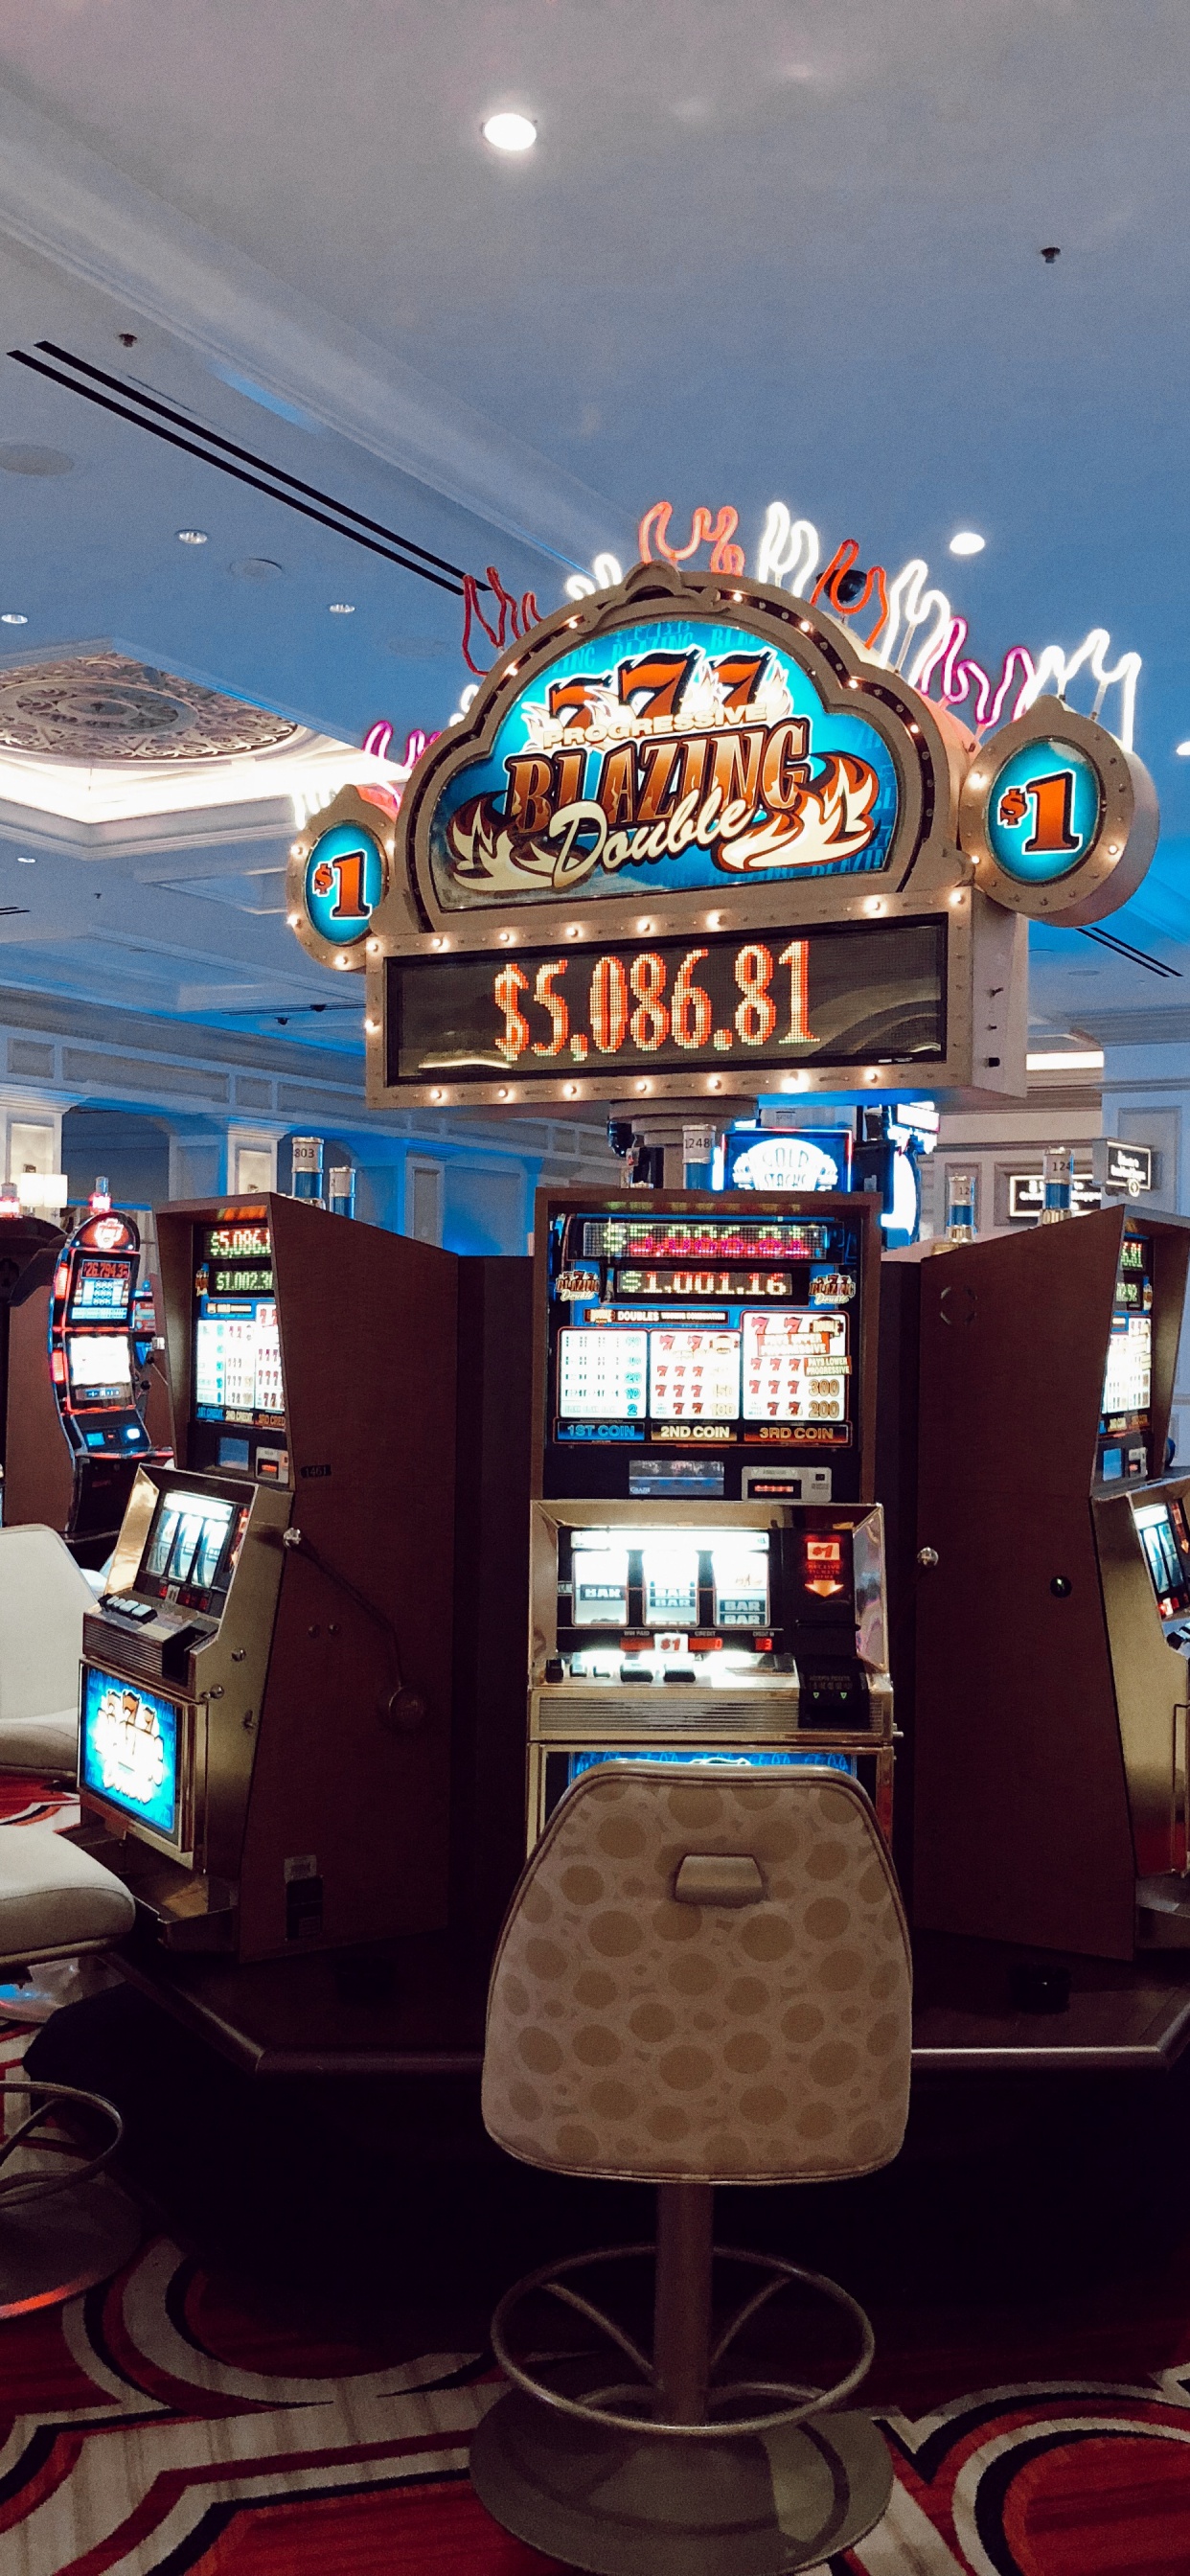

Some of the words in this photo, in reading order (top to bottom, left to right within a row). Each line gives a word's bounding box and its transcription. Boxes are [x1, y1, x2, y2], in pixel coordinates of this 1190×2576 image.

[543, 702, 767, 749] PROGRESSIVE
[506, 719, 811, 836] BLAZING
[998, 770, 1082, 854] $1
[549, 786, 754, 888] Double
[313, 850, 371, 919] $1
[494, 941, 821, 1062] $5,086.81
[617, 1312, 660, 1322] DOUBLES
[825, 1356, 848, 1366] LOWER
[808, 1379, 840, 1397] 300
[627, 1403, 638, 1416] 2
[808, 1400, 840, 1419] 200
[567, 1425, 595, 1437] 1ST
[597, 1425, 635, 1438] COIN
[660, 1425, 692, 1438] 2ND
[692, 1426, 730, 1438] COIN
[759, 1427, 792, 1439] 3RD
[793, 1427, 834, 1439] COIN
[654, 1598, 691, 1607] BAR
[724, 1600, 760, 1611] BAR
[724, 1614, 760, 1625] BAR
[660, 1637, 681, 1650] $1
[765, 1638, 772, 1650] 3
